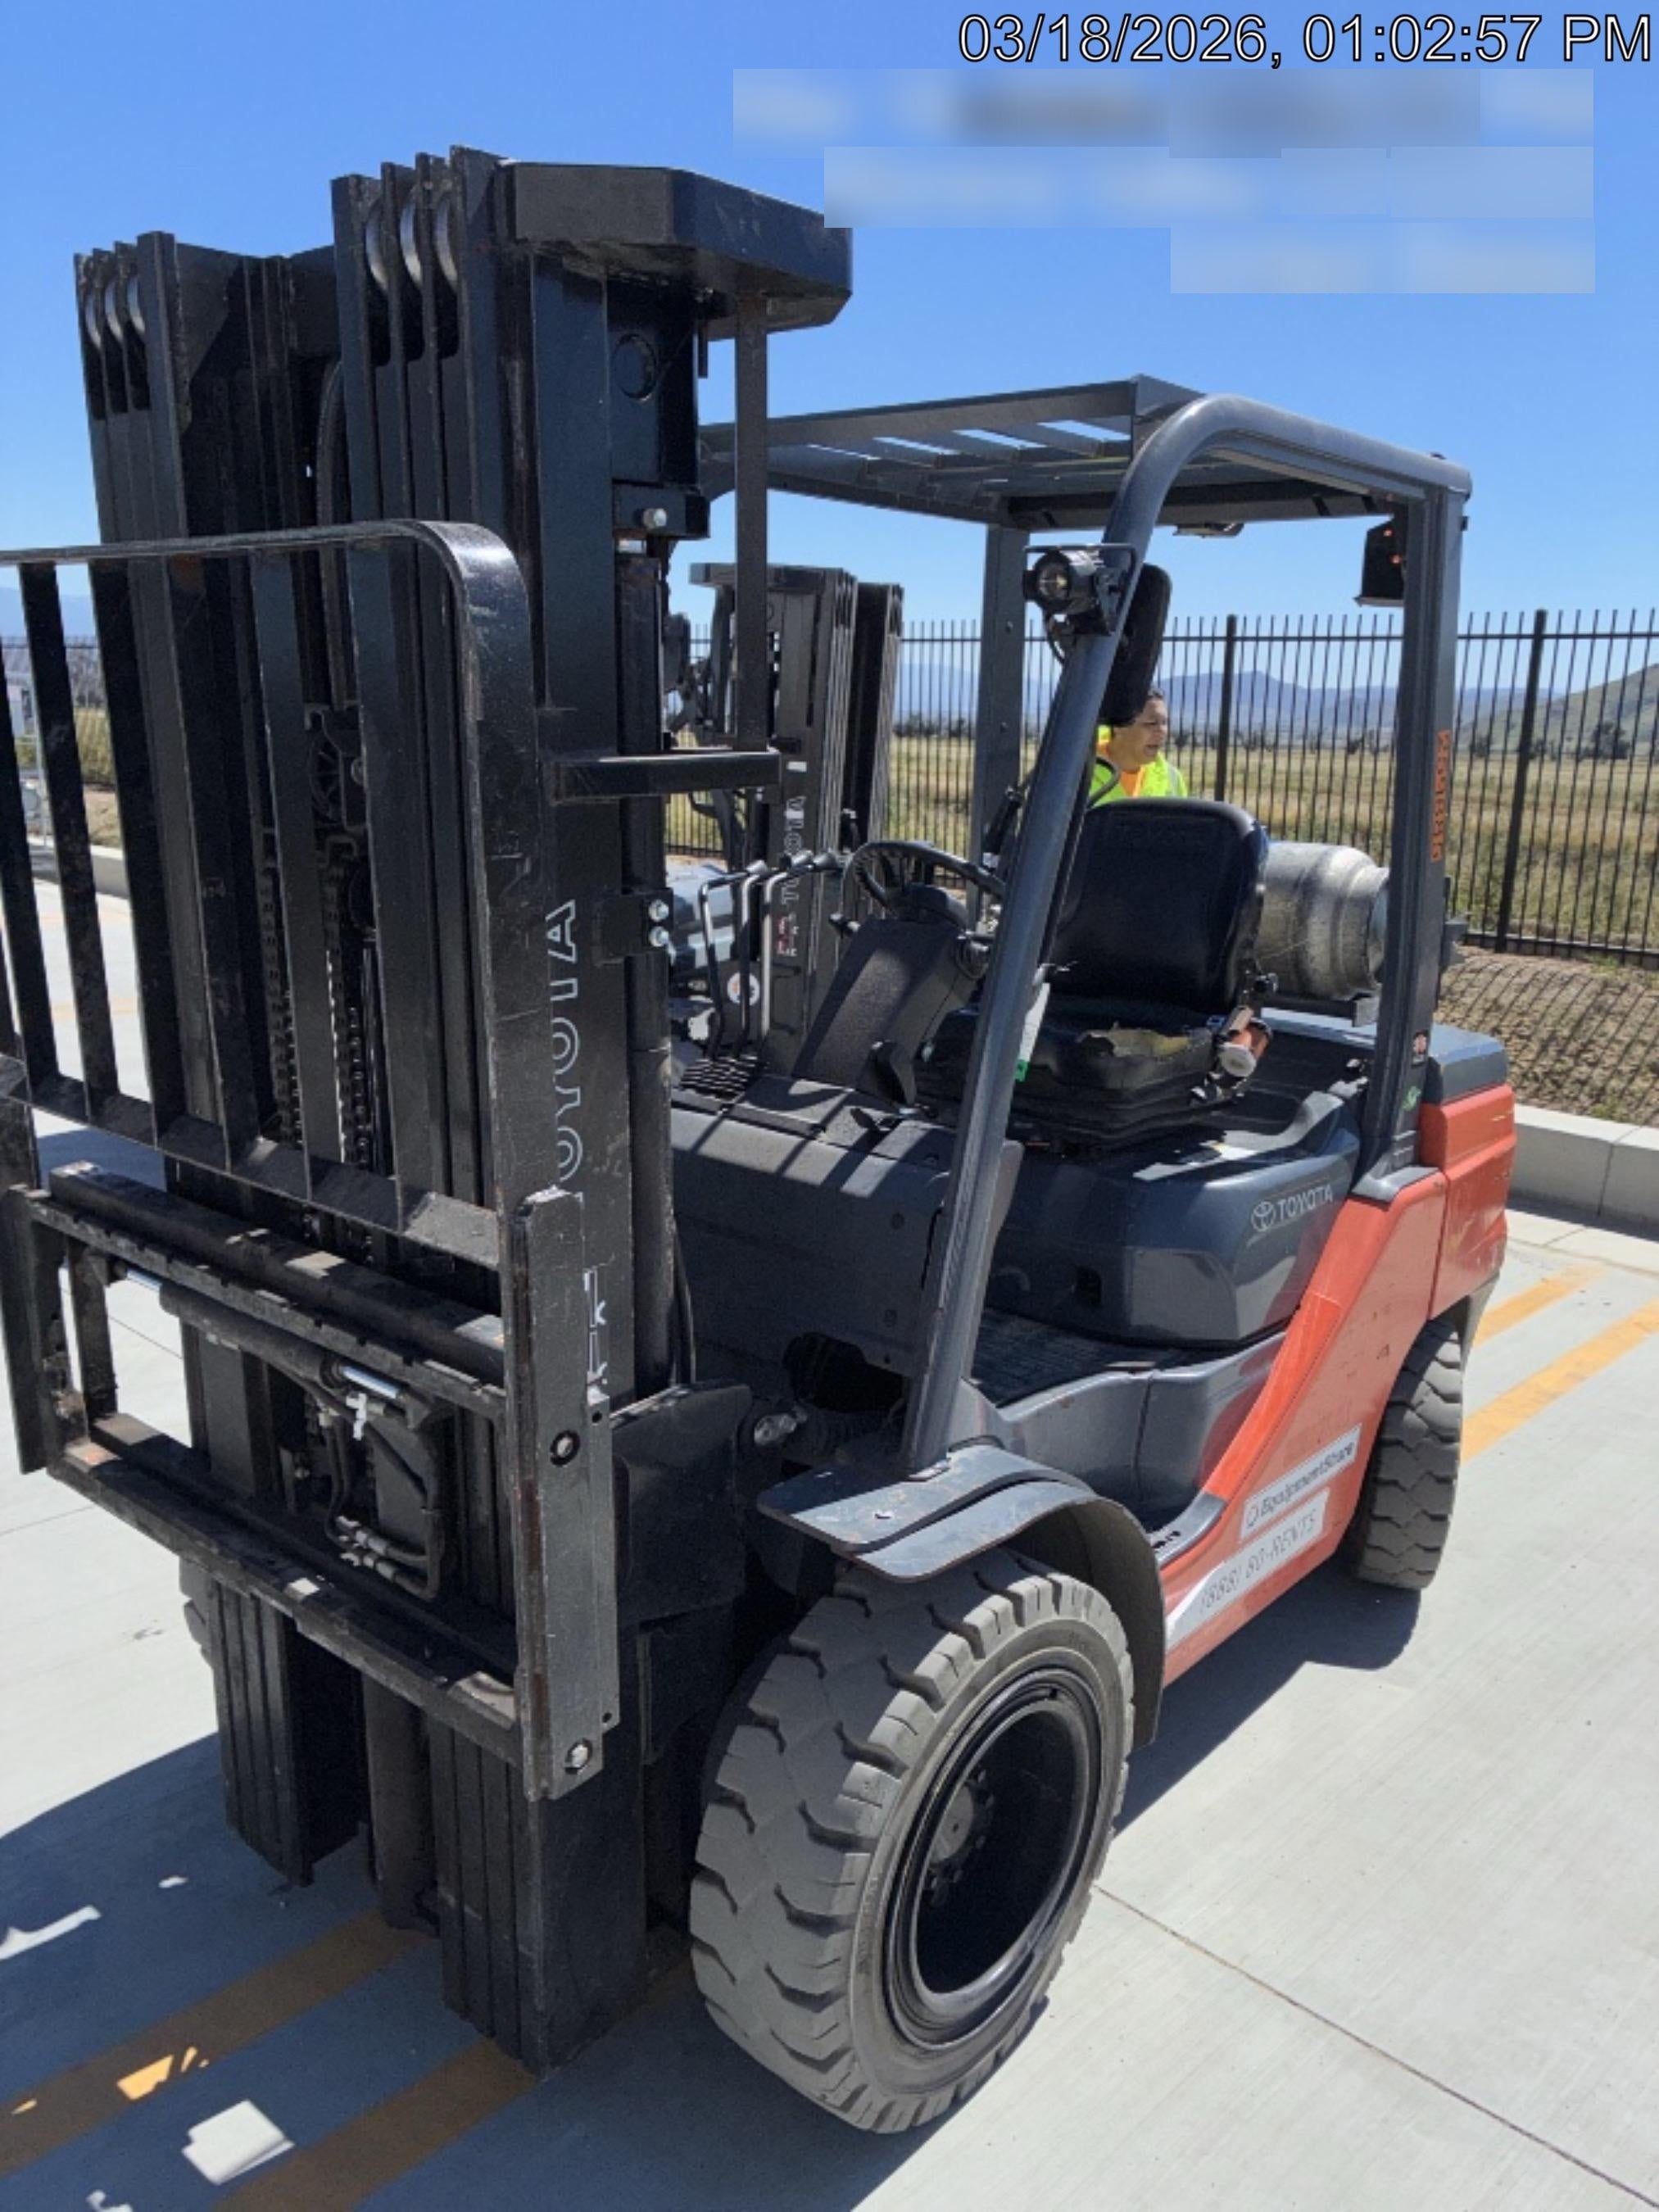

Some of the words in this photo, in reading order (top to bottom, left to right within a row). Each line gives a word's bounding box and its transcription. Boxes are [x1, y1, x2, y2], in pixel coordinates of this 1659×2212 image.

[782, 796, 806, 904] TOOTA
[546, 899, 582, 1203] OYOTA
[1277, 1184, 1333, 1220] TOYOTA
